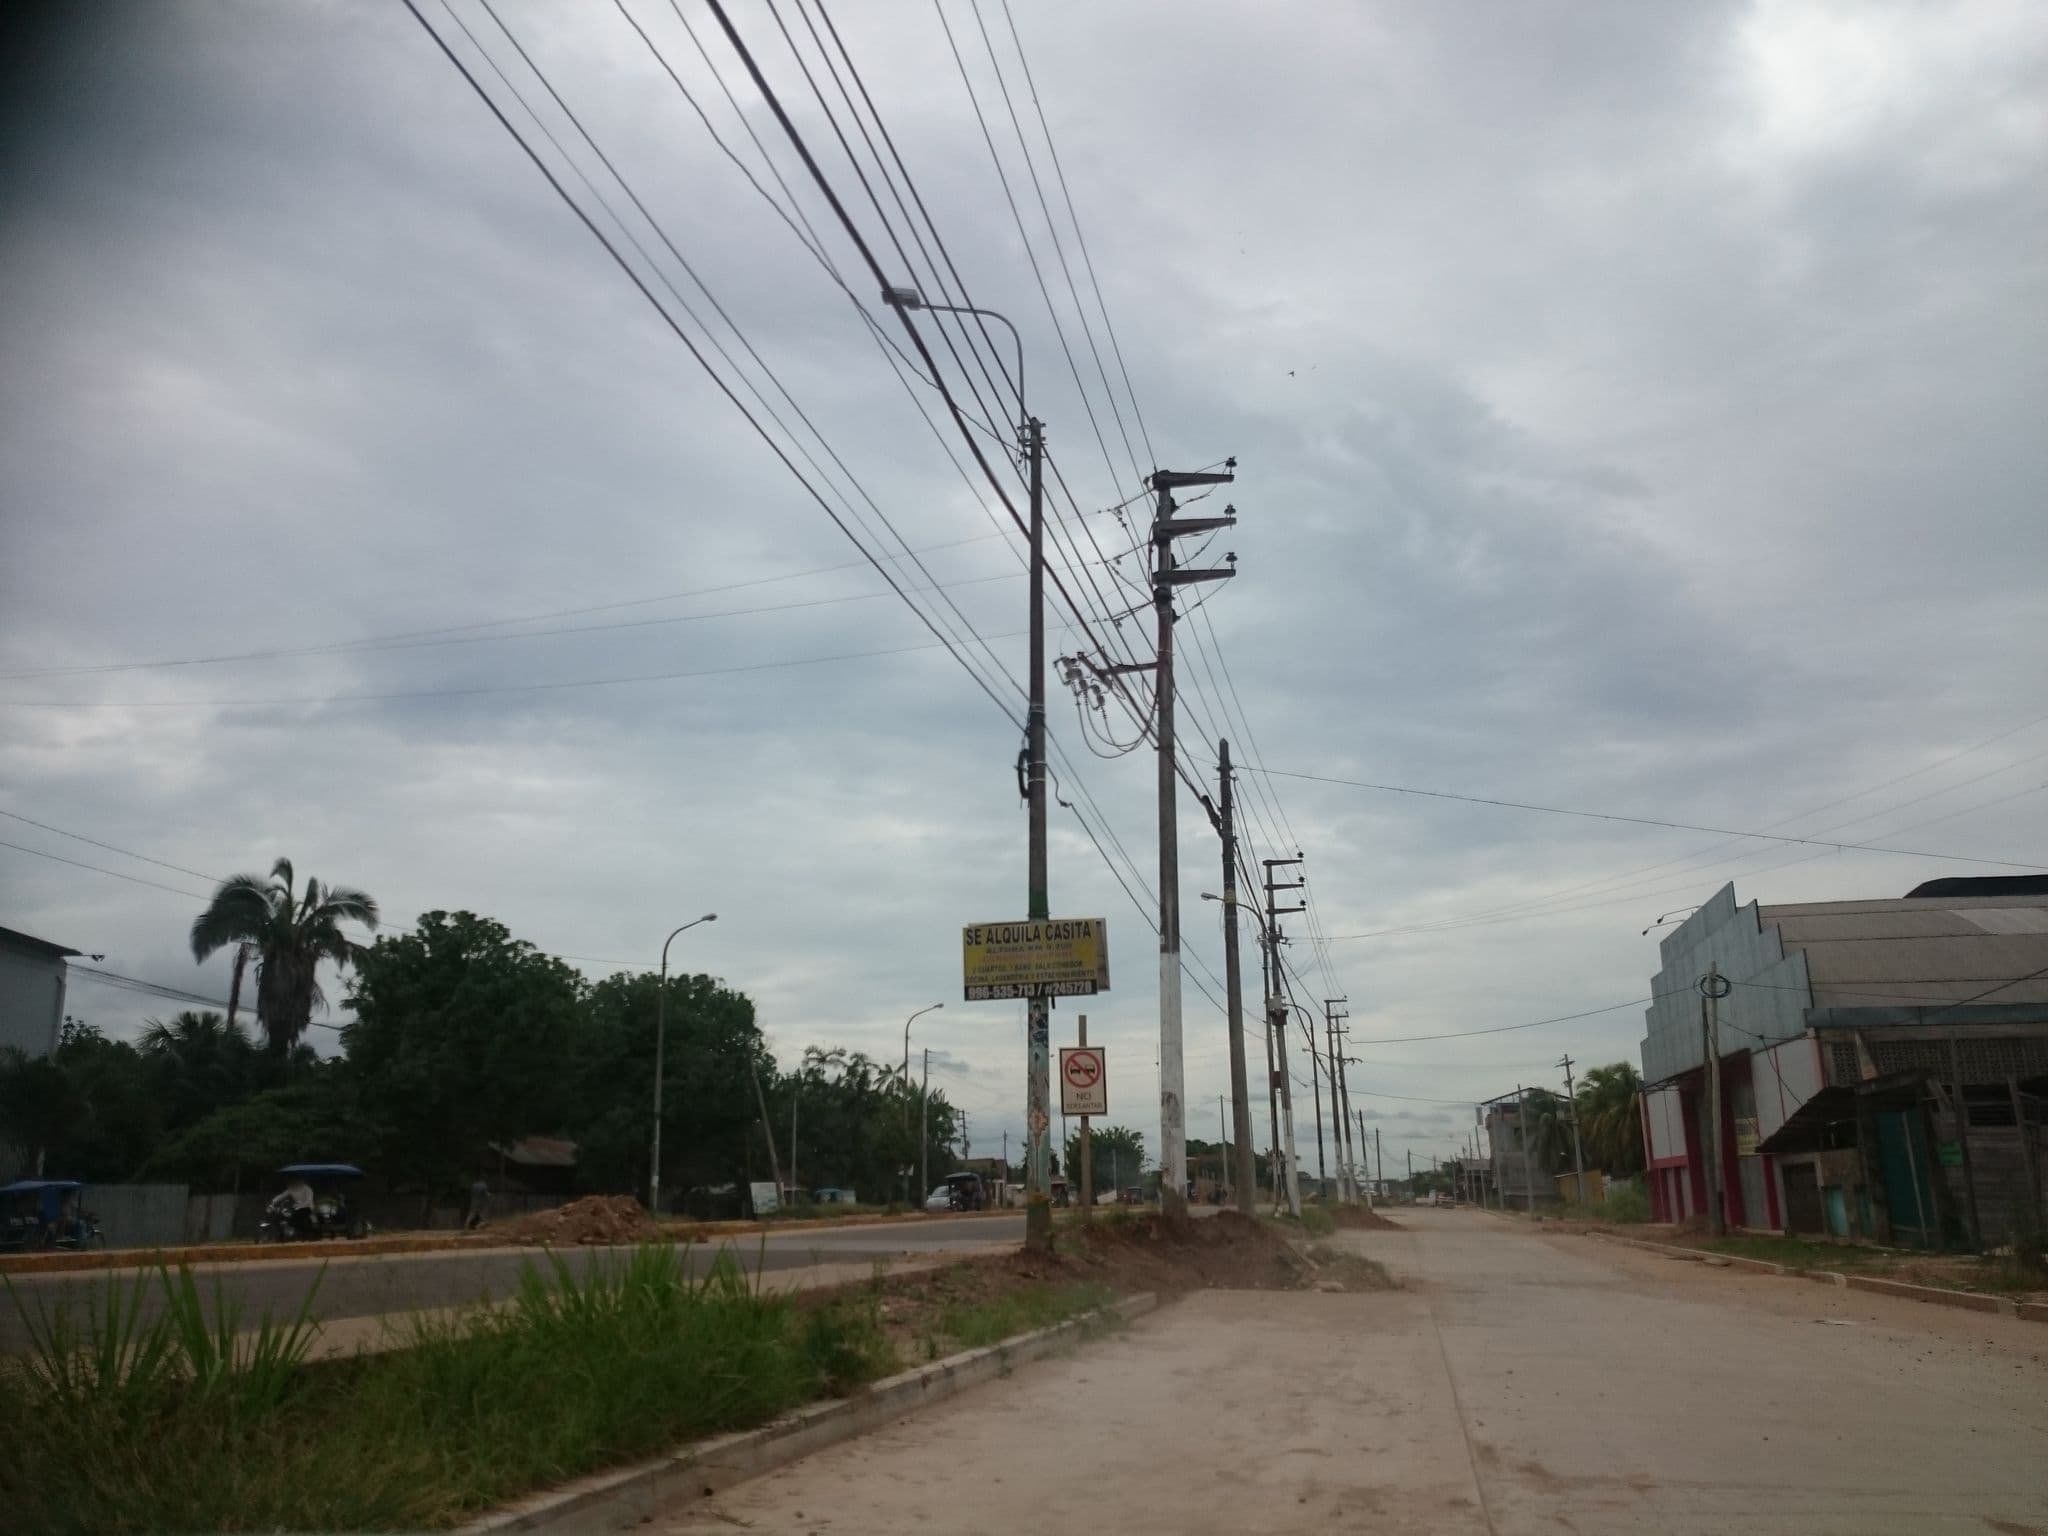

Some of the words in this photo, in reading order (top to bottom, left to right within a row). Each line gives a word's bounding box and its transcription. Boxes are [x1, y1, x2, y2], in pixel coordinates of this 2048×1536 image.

[966, 929, 981, 945] SE
[987, 924, 1041, 944] ALQUILA
[1045, 921, 1091, 941] CASITA
[1076, 1092, 1092, 1101] NO
